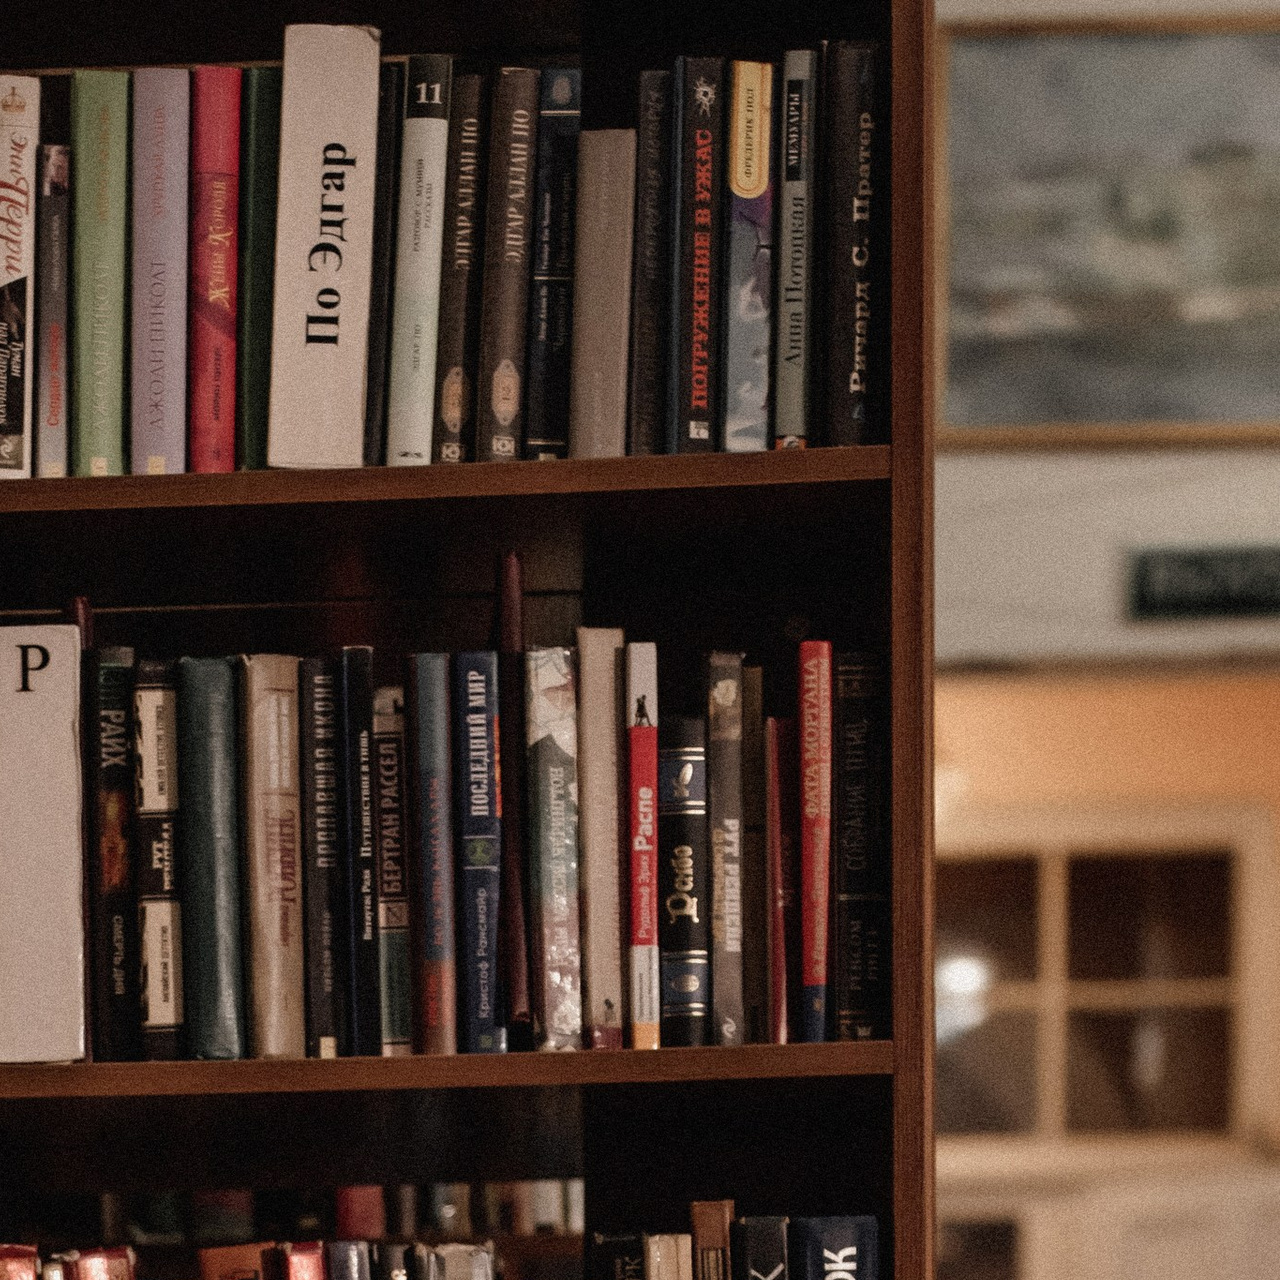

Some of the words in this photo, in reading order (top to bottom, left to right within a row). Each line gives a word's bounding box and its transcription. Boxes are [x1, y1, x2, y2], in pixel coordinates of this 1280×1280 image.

[460, 118, 479, 144] ПО
[510, 109, 530, 136] ПО
[785, 91, 802, 166] МЕМУАРЫ
[695, 129, 713, 201] УЖАС
[852, 111, 875, 222] Пратер
[306, 142, 355, 272] Эдгар
[693, 208, 711, 225] В
[785, 196, 806, 305] Потоцкая
[850, 237, 870, 267] С.
[304, 286, 341, 346] По
[690, 232, 710, 409] ПОГРУЖЕНИЕ
[784, 311, 803, 366] Анна
[849, 281, 871, 393] Ричард
[466, 670, 488, 708] МИР
[100, 710, 131, 768] РАЙХ
[468, 713, 491, 816] ПОСЛЕДНИЙ
[379, 742, 400, 809] РАССЕЛ
[633, 786, 655, 851] Распе
[383, 812, 403, 893] БЕРТРАН
